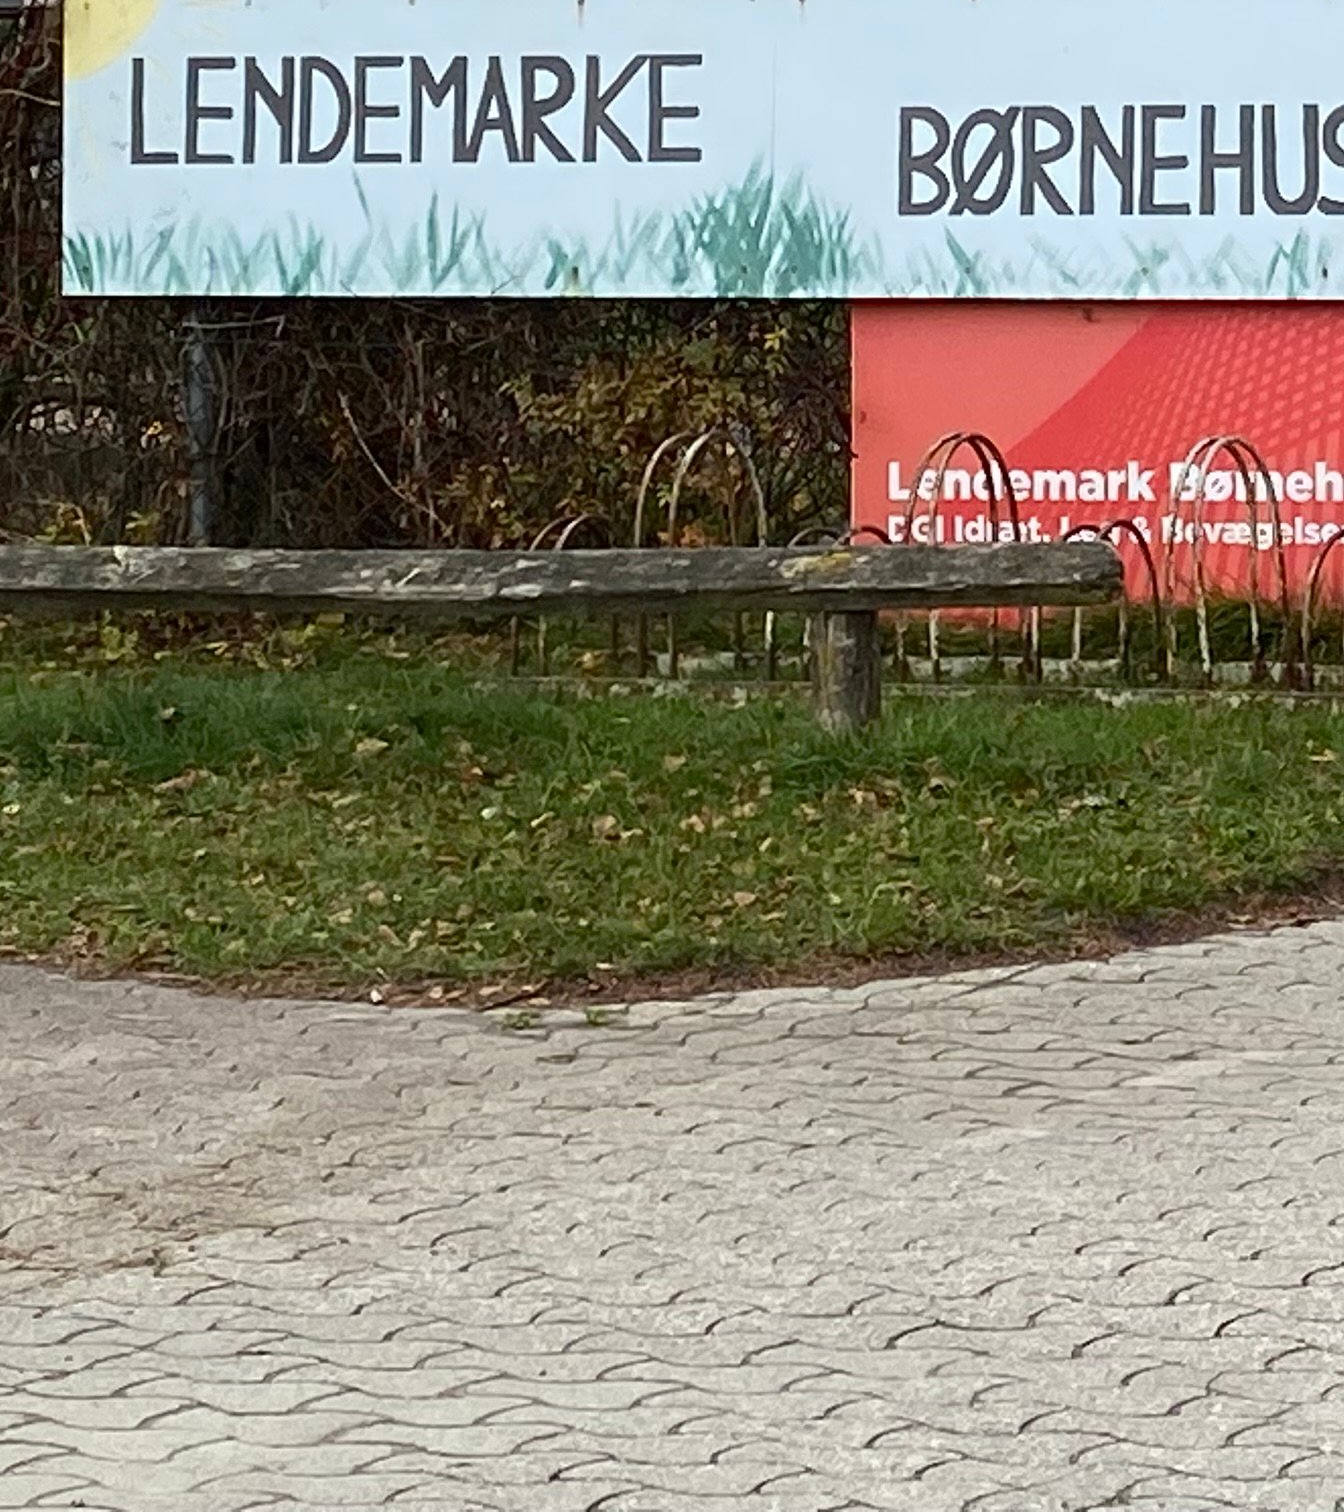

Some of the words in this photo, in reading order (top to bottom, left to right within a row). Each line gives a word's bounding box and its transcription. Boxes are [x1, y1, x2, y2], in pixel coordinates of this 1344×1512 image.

[130, 54, 703, 166] LENDEMARKE
[887, 461, 1156, 502] Lendemark
[888, 514, 946, 544] DGI
[1131, 516, 1152, 544] &
